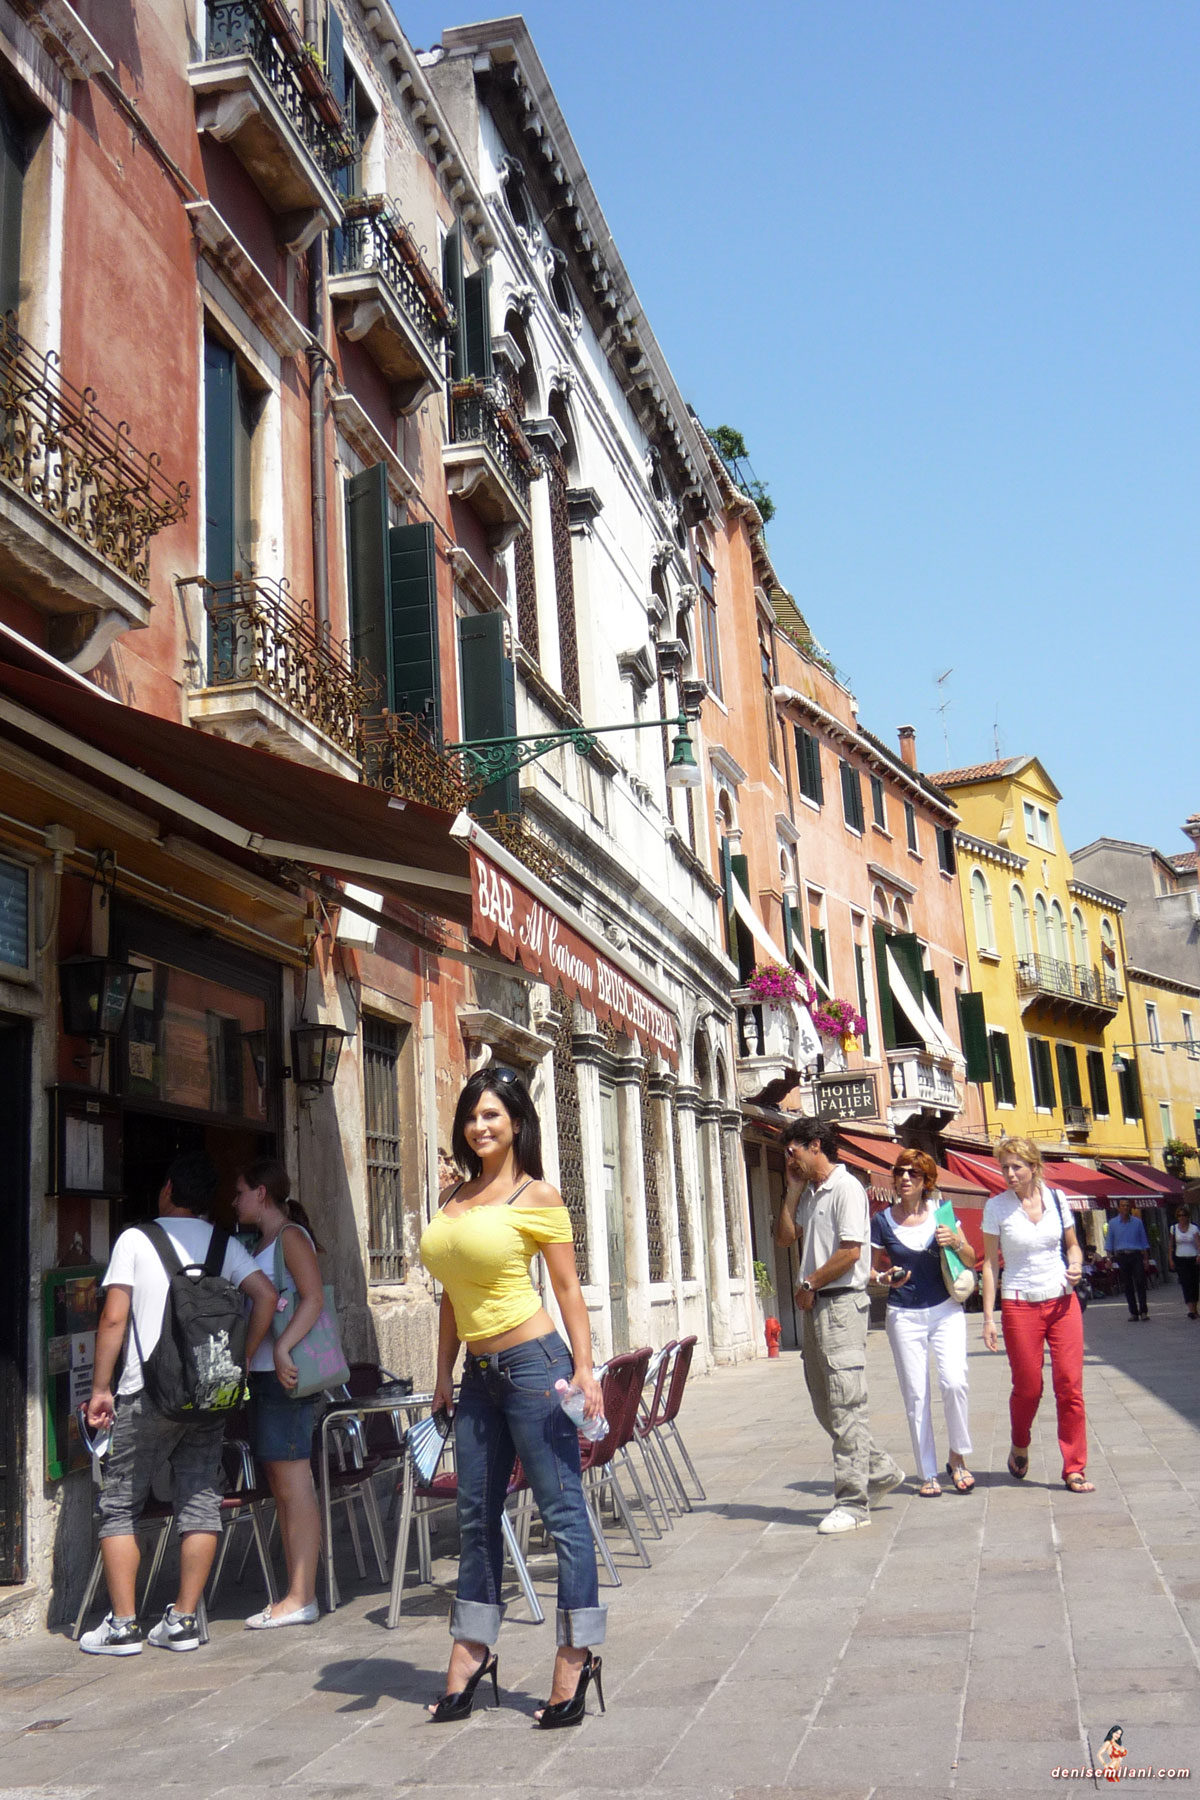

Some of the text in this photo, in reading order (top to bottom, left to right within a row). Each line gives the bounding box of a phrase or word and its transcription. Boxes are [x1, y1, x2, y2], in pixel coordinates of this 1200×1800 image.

[475, 857, 515, 937] BAR
[596, 957, 677, 1052] BRUSCHETTERIA
[821, 1083, 871, 1098] HOTEL
[820, 1095, 873, 1111] FALIER
